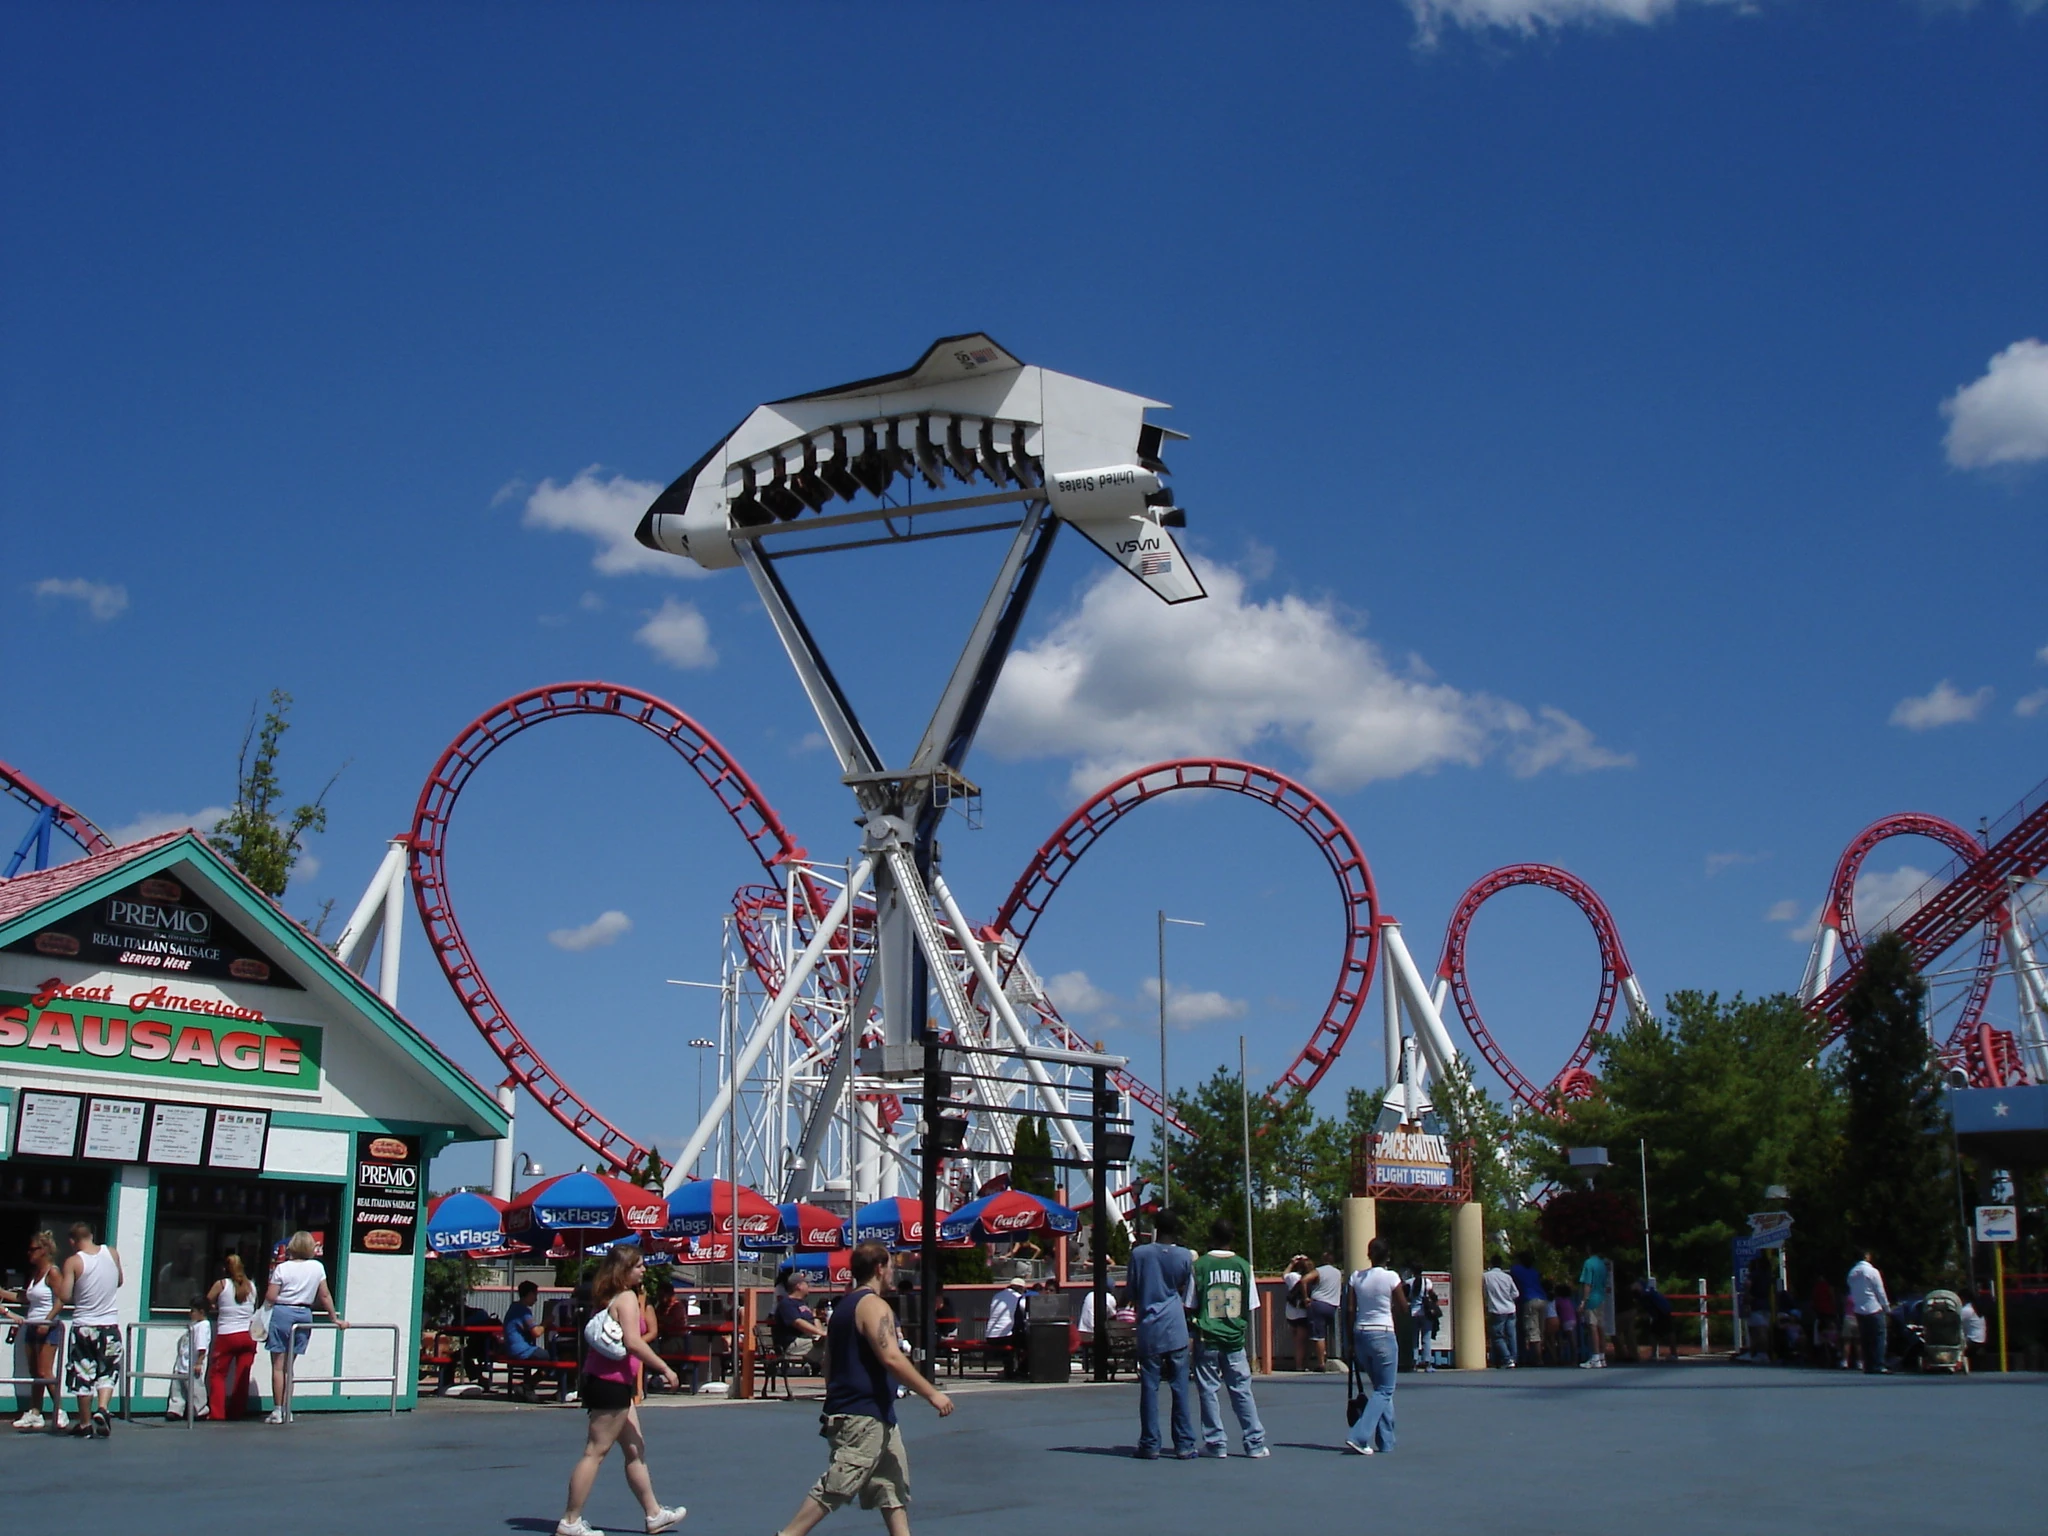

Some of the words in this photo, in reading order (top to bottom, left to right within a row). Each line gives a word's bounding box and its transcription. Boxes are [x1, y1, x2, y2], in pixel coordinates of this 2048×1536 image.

[1059, 477, 1094, 492] States
[1100, 470, 1135, 489] United
[110, 900, 208, 934] PREMIO
[92, 932, 122, 948] REAL
[124, 936, 168, 954] ITALIAN
[170, 943, 221, 961] SAUSAGE
[120, 951, 161, 967] SERVED
[163, 956, 192, 971] HERE
[32, 977, 114, 1009] Great
[129, 985, 266, 1024] American
[0, 1006, 301, 1074] SAUSAGE
[1407, 1133, 1452, 1164] SHUTTLE
[361, 1164, 416, 1187] PREMIO
[1376, 1167, 1409, 1184] FLIGHT
[1410, 1169, 1447, 1186] TESTING
[357, 1197, 370, 1207] REAL
[370, 1198, 392, 1209] ITALIAN
[392, 1200, 416, 1210] SAUSAGE
[356, 1211, 390, 1223] SERVED
[391, 1214, 413, 1225] HERE
[1207, 1269, 1242, 1286] JAMES
[1207, 1287, 1242, 1319] 23
